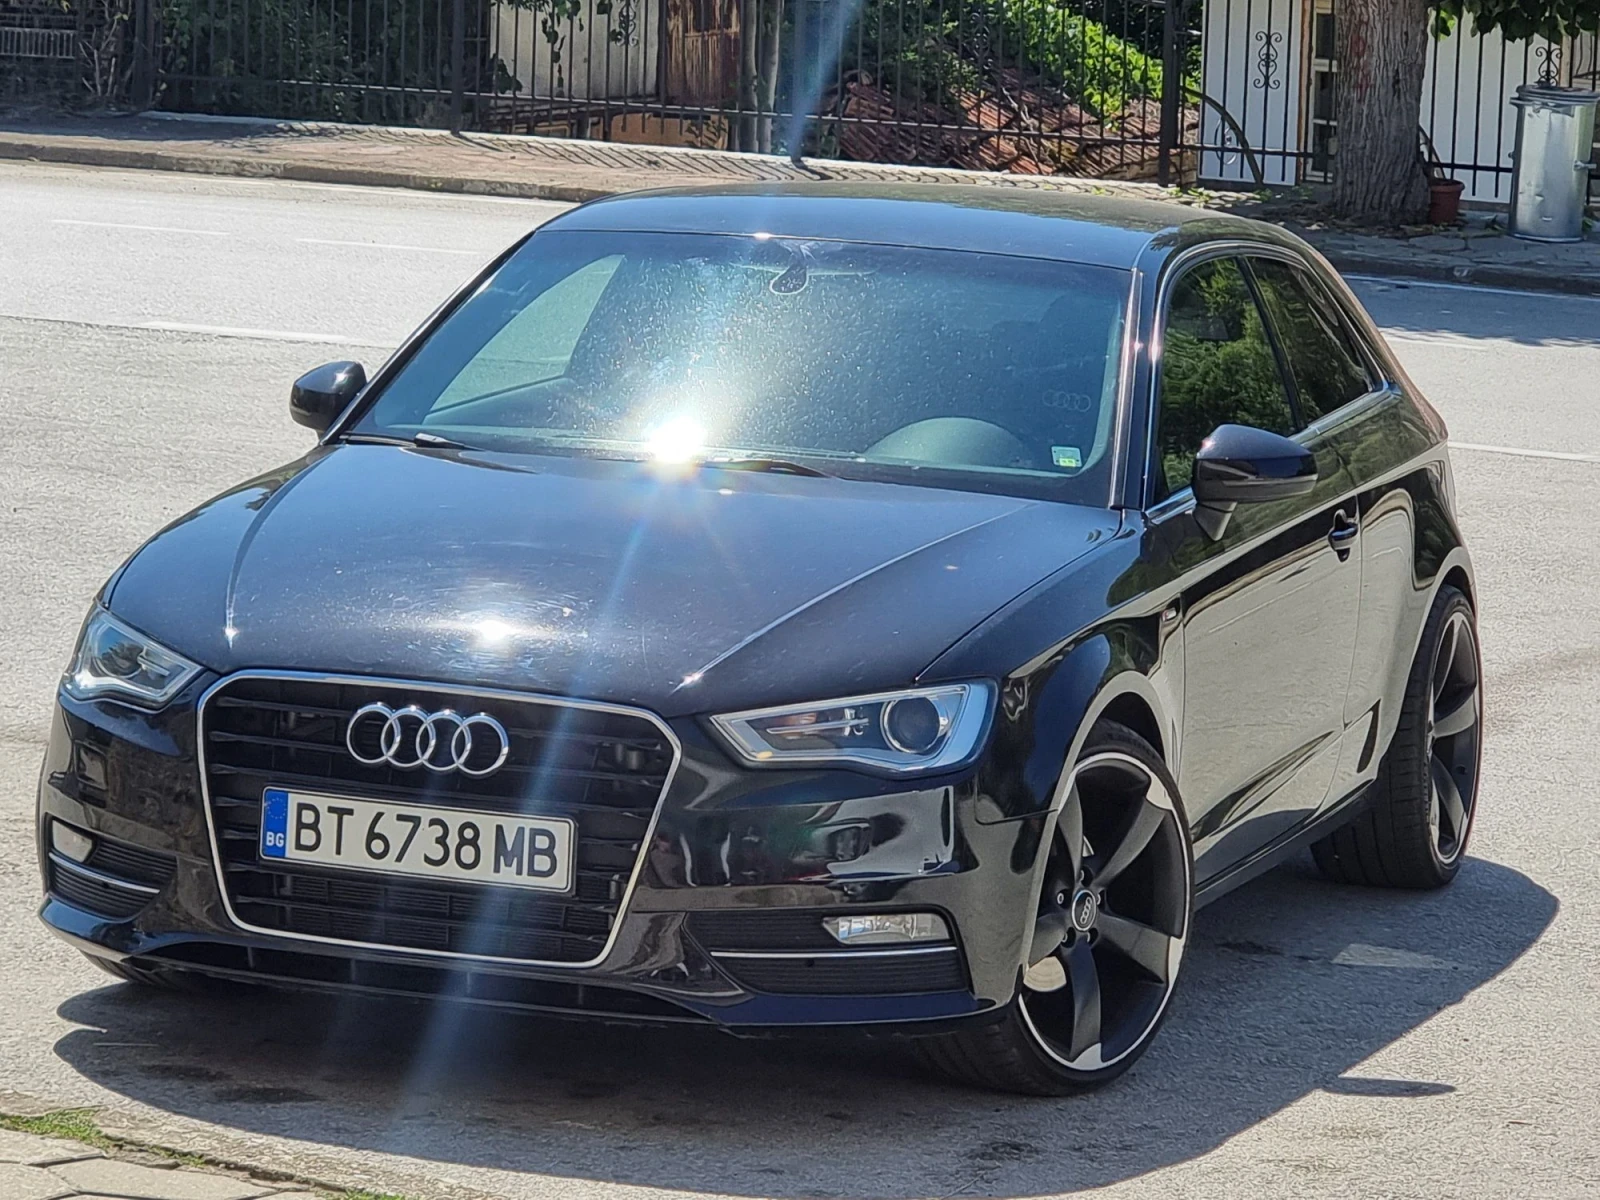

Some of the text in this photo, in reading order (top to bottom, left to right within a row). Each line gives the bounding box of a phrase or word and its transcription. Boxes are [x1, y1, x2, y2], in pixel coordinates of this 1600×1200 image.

[265, 831, 285, 848] BG
[294, 802, 558, 878] BT 6738 MB
